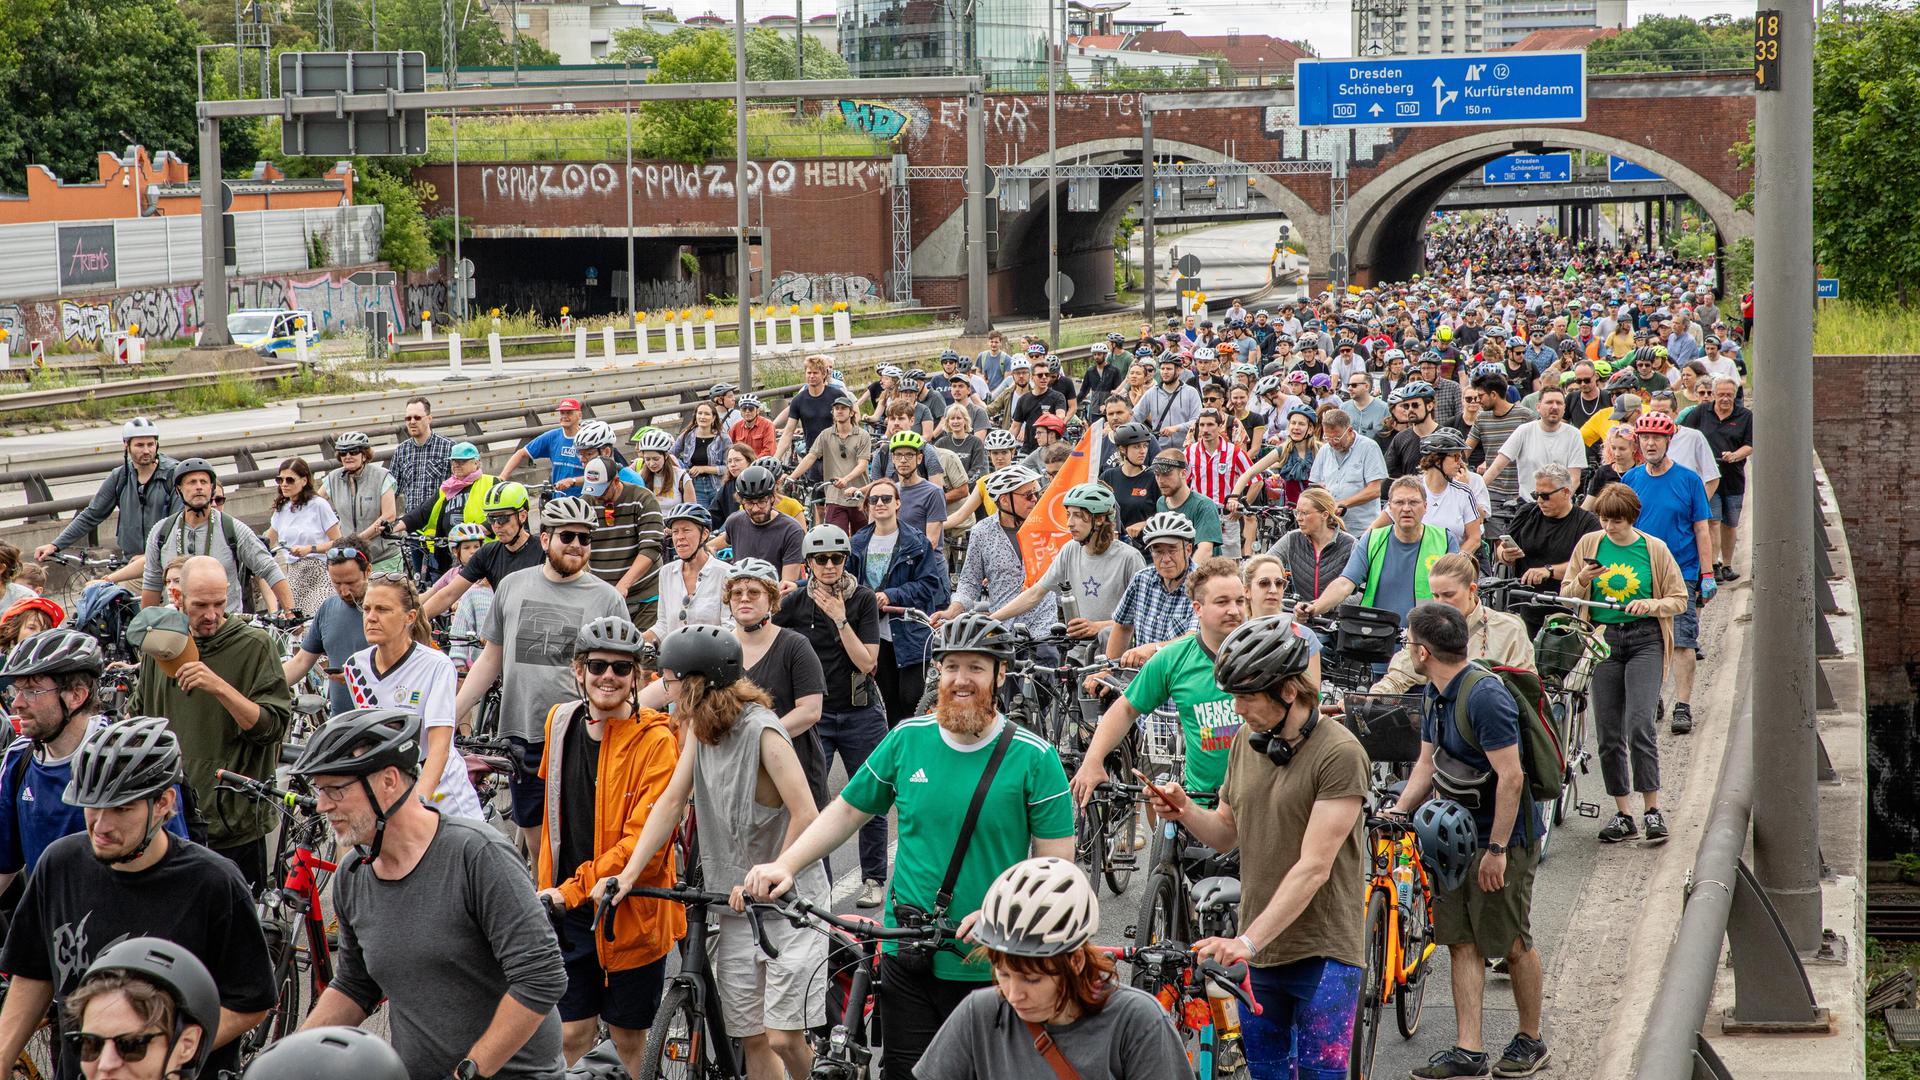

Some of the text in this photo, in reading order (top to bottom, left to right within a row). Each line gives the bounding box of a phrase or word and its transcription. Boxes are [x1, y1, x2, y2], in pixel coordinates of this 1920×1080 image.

[1757, 16, 1779, 37] 18
[1755, 40, 1778, 61] 33
[1349, 67, 1402, 80] Dresden
[1496, 67, 1507, 77] 12
[1339, 83, 1414, 96] Schöneberg
[1464, 84, 1574, 98] Kurfürstendamm
[1336, 106, 1353, 115] 100
[1399, 104, 1416, 113] 100
[1465, 105, 1481, 114] 150
[1201, 735, 1232, 751] ANTR
